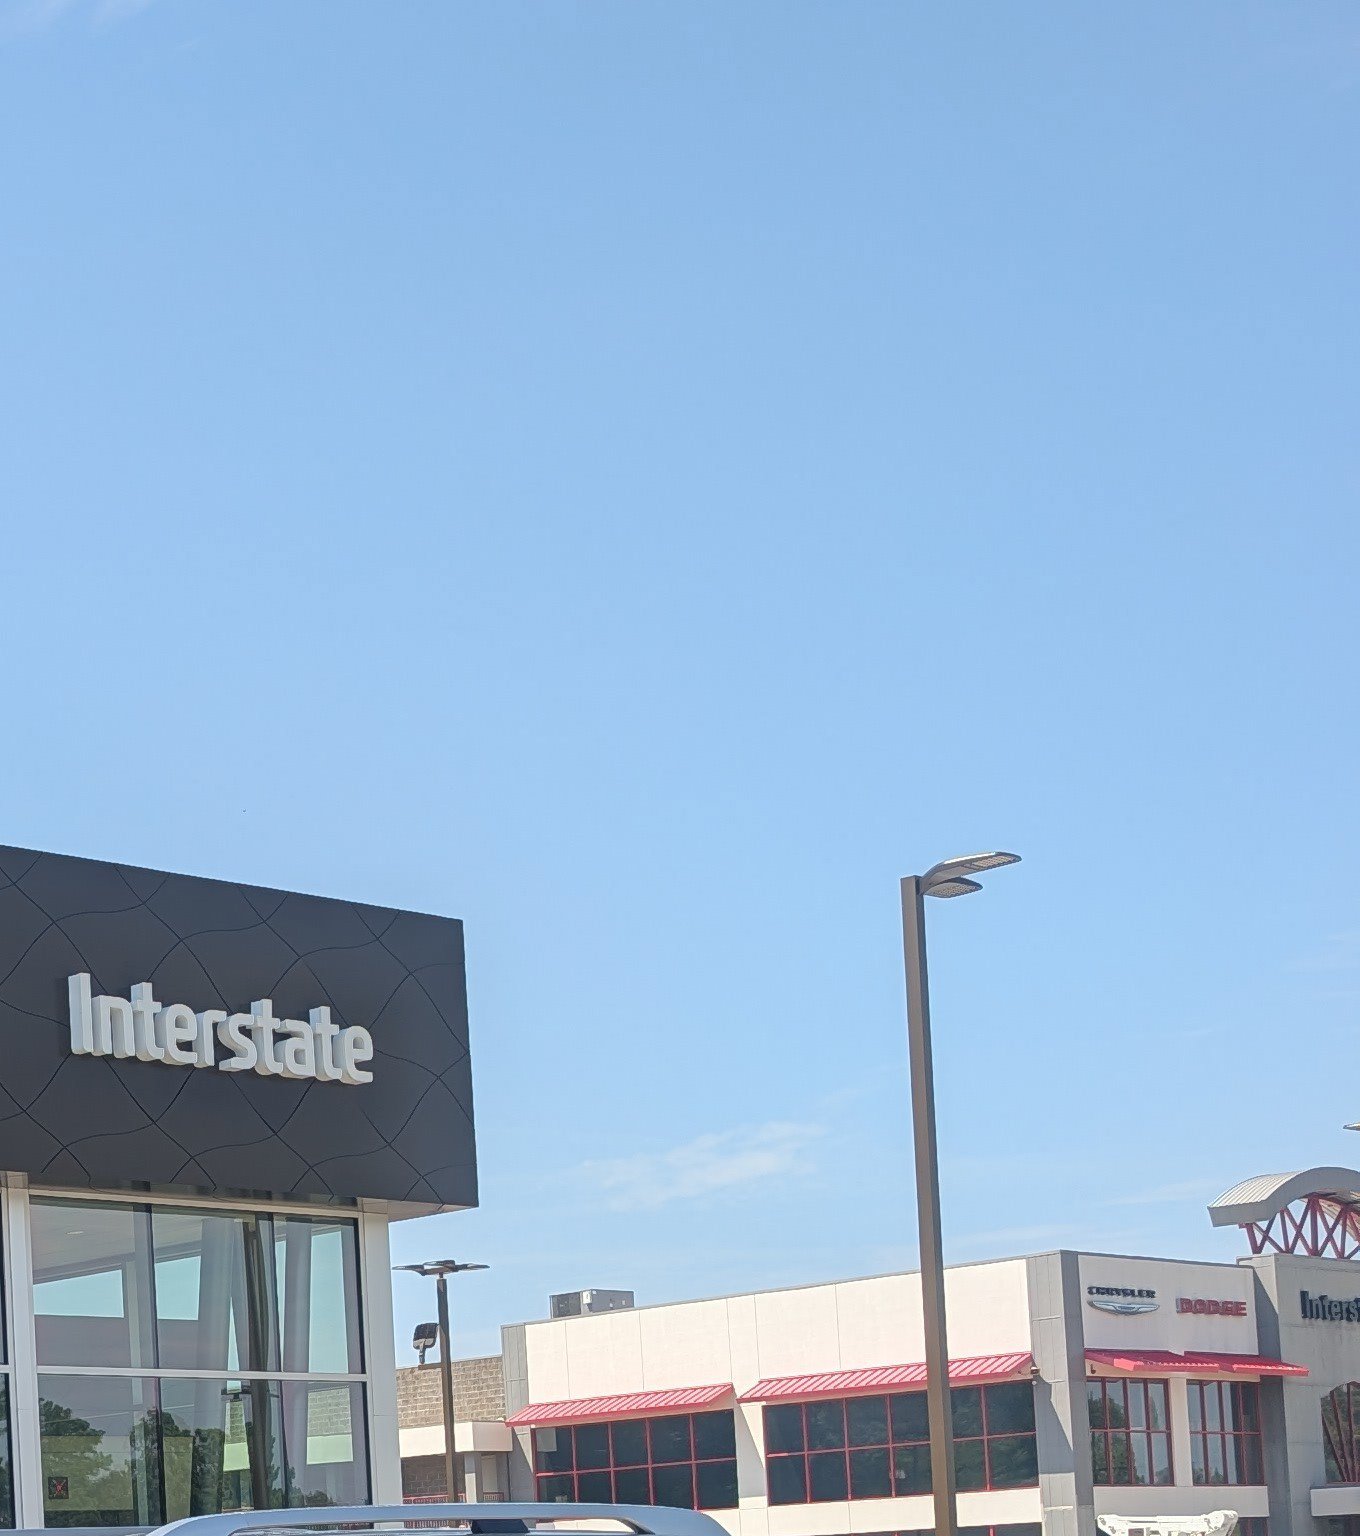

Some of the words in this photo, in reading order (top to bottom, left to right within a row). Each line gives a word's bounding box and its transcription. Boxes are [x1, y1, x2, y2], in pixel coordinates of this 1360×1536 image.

[68, 972, 374, 1085] Interstate
[1087, 1286, 1156, 1299] CHRYSLER
[1176, 1298, 1247, 1316] DODGE
[1300, 1290, 1360, 1322] Inters
